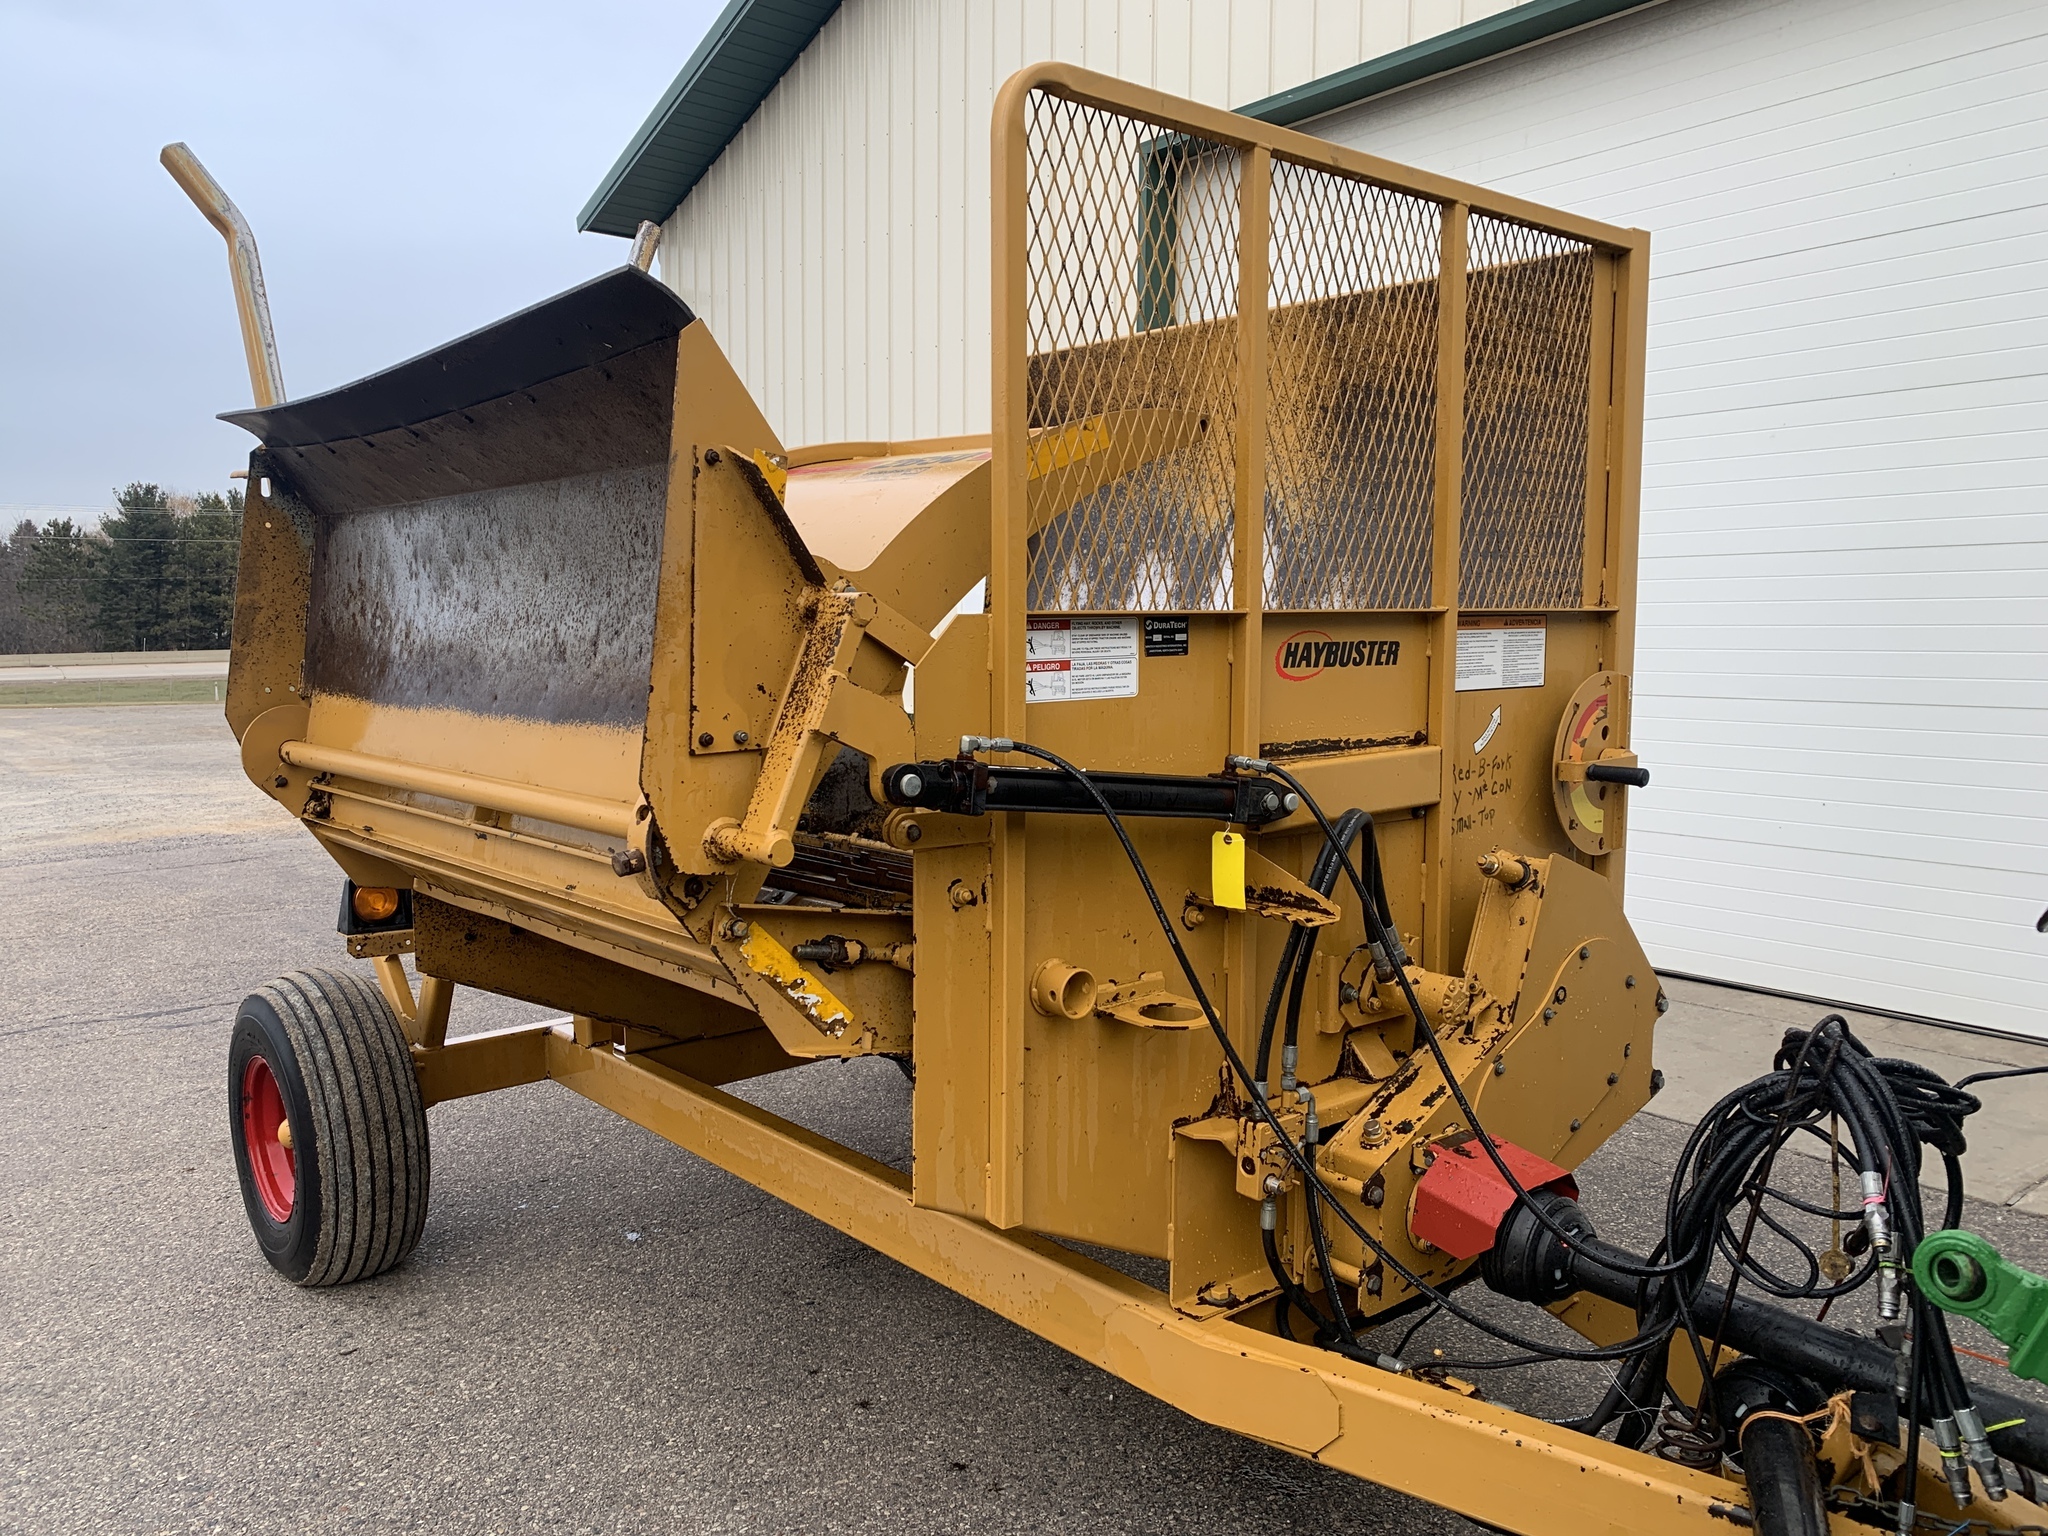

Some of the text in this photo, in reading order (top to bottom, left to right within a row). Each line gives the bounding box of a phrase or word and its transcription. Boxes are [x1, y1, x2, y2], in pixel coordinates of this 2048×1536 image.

[1033, 621, 1060, 630] DANGER
[1283, 640, 1400, 668] HAYBUSTER
[1033, 663, 1060, 671] PELIGRO
